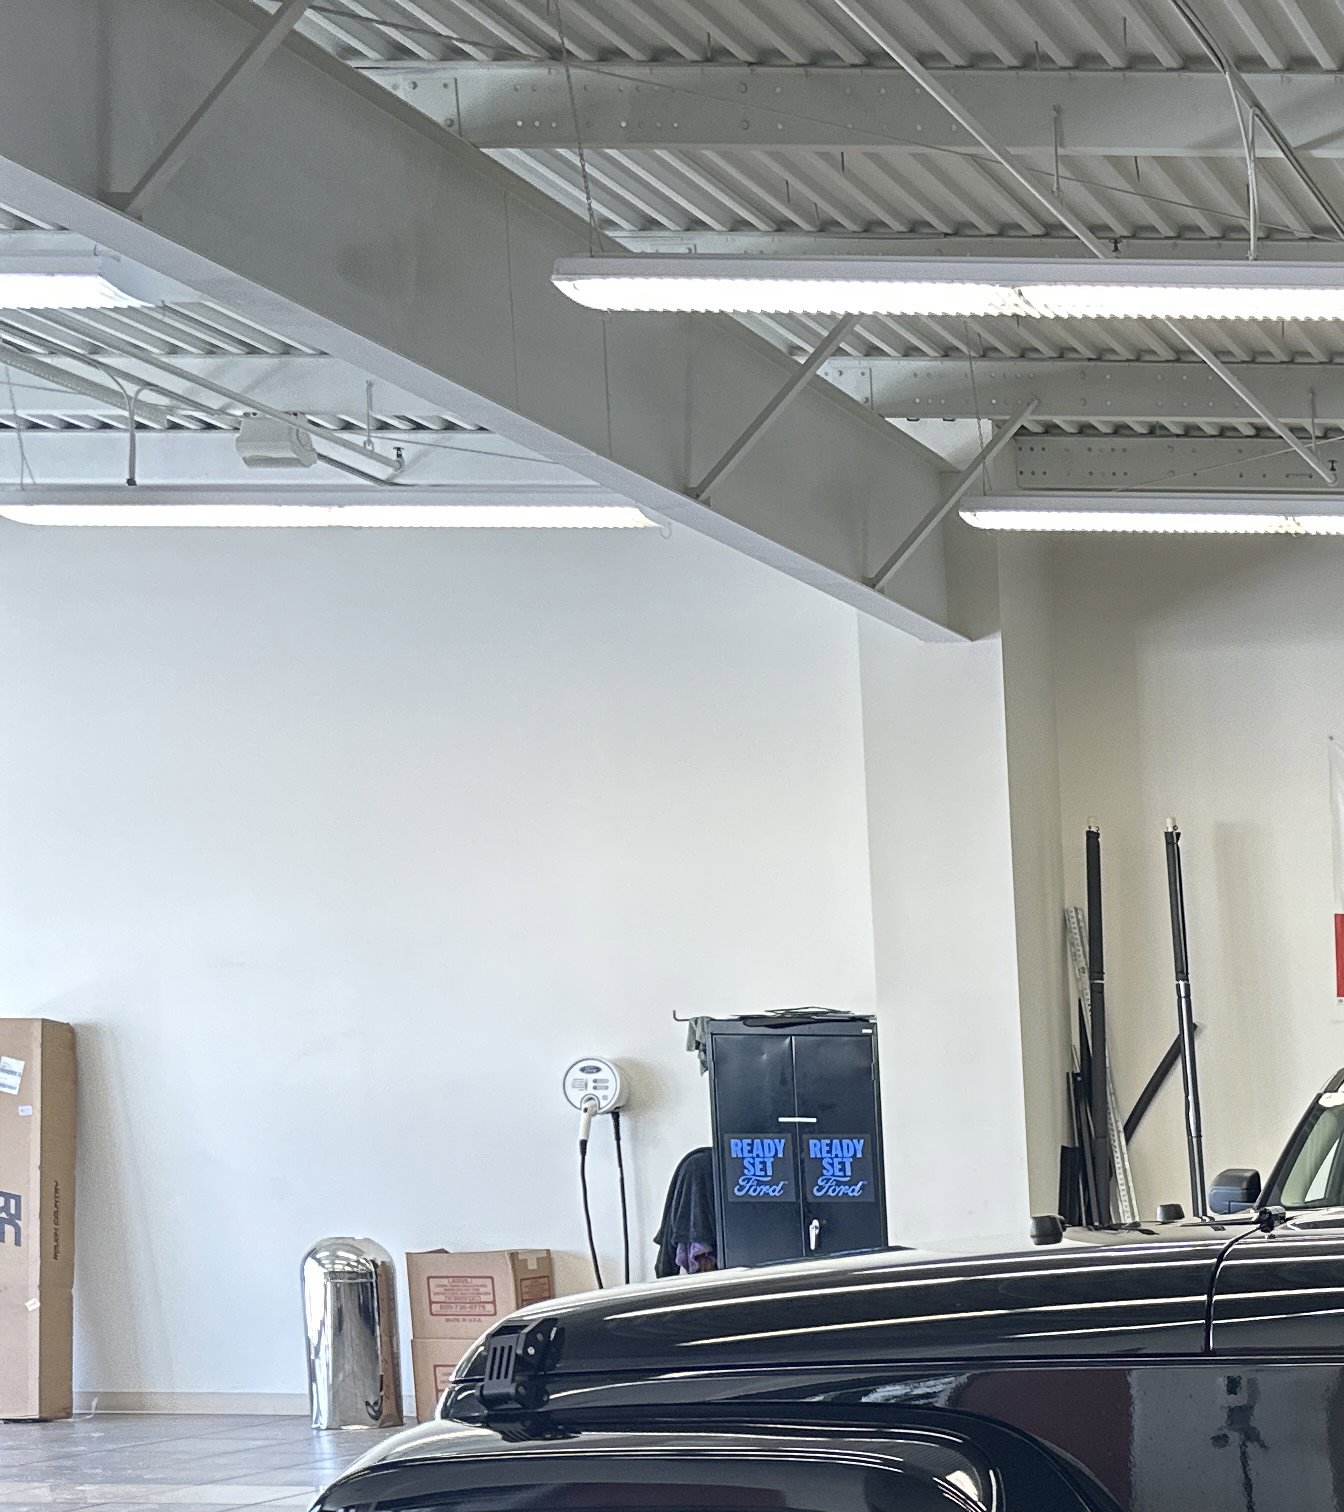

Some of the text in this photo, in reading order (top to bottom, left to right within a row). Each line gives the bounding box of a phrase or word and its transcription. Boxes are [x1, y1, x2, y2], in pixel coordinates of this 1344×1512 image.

[730, 1138, 785, 1158] READY
[809, 1138, 864, 1158] READY
[743, 1157, 774, 1176] SET
[822, 1157, 853, 1176] SET
[734, 1175, 785, 1197] Ford
[813, 1175, 864, 1197] Ford
